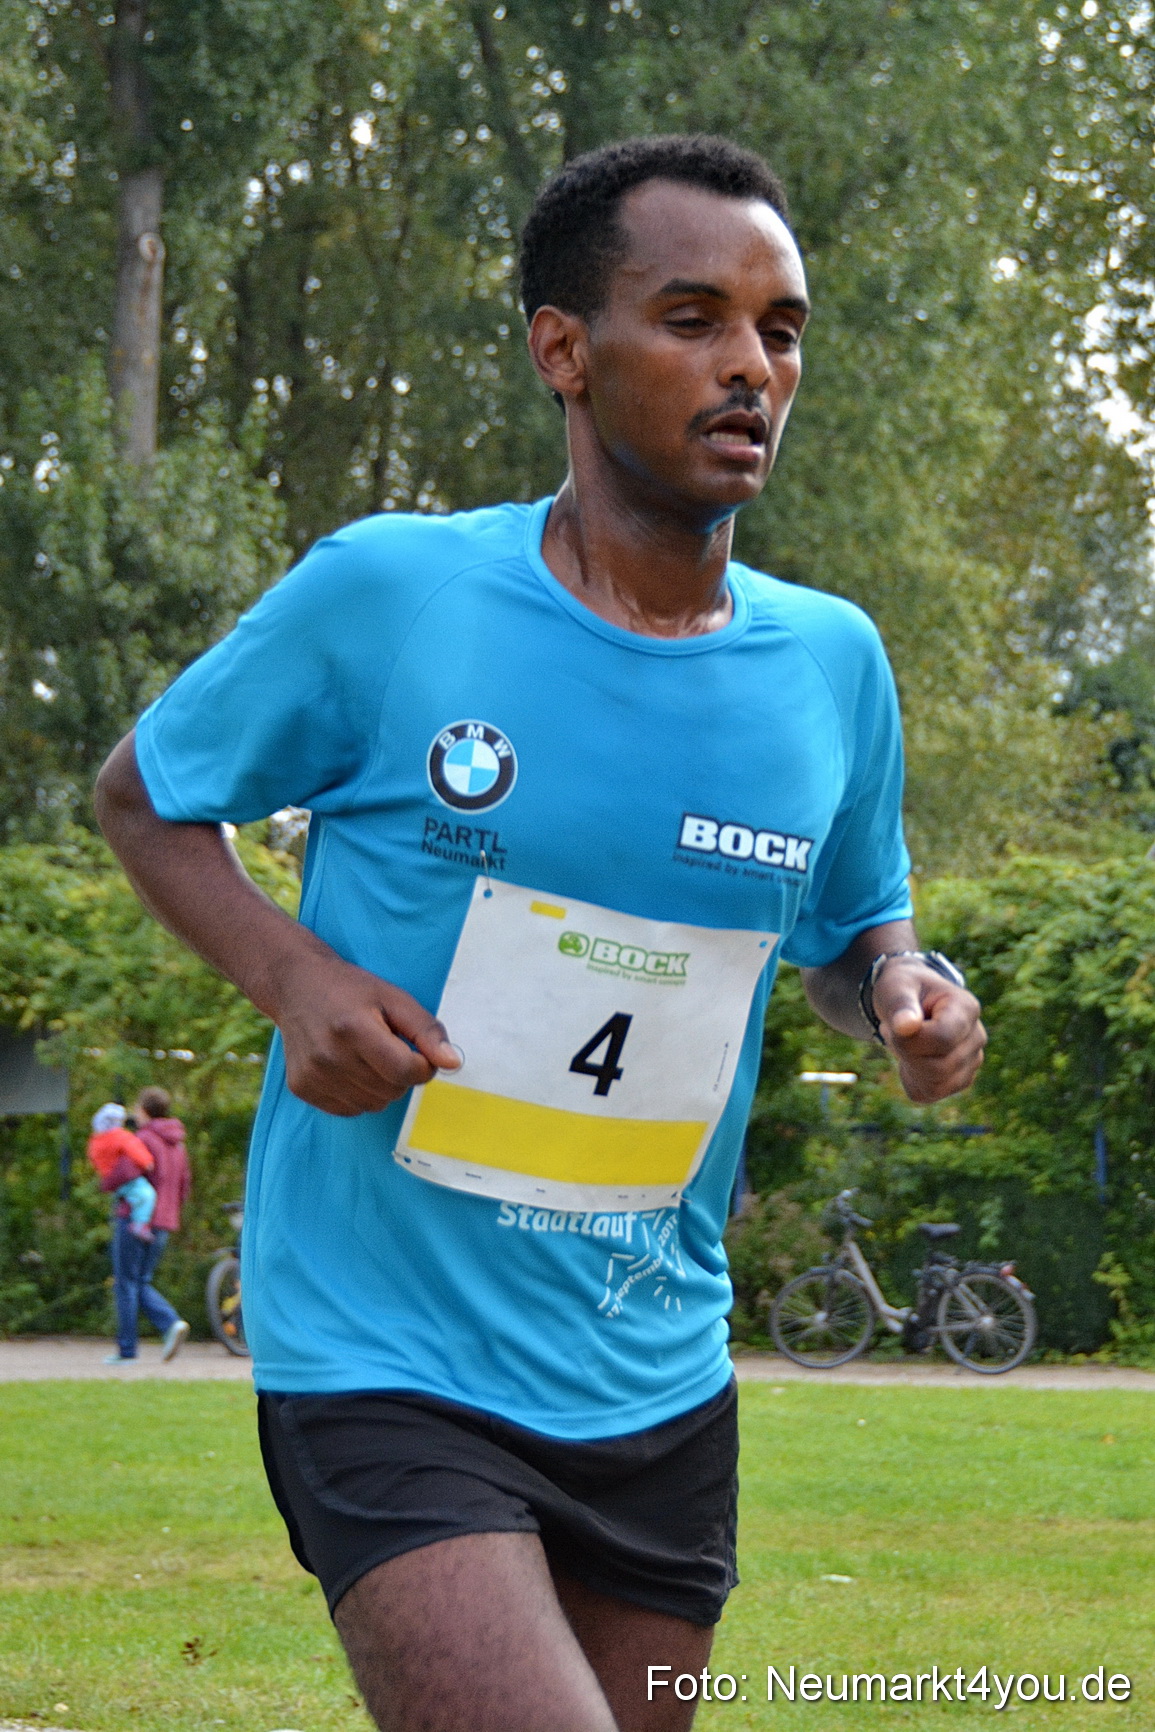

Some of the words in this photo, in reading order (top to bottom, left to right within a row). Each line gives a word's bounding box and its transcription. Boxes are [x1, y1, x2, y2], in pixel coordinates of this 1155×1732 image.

[438, 723, 512, 759] BMW
[423, 816, 508, 854] PARTL
[678, 813, 814, 873] BOCK
[421, 839, 506, 871] Neumarkt
[590, 937, 690, 976] BOCK
[568, 1011, 634, 1097] 4
[497, 1200, 637, 1243] Stadtlauf
